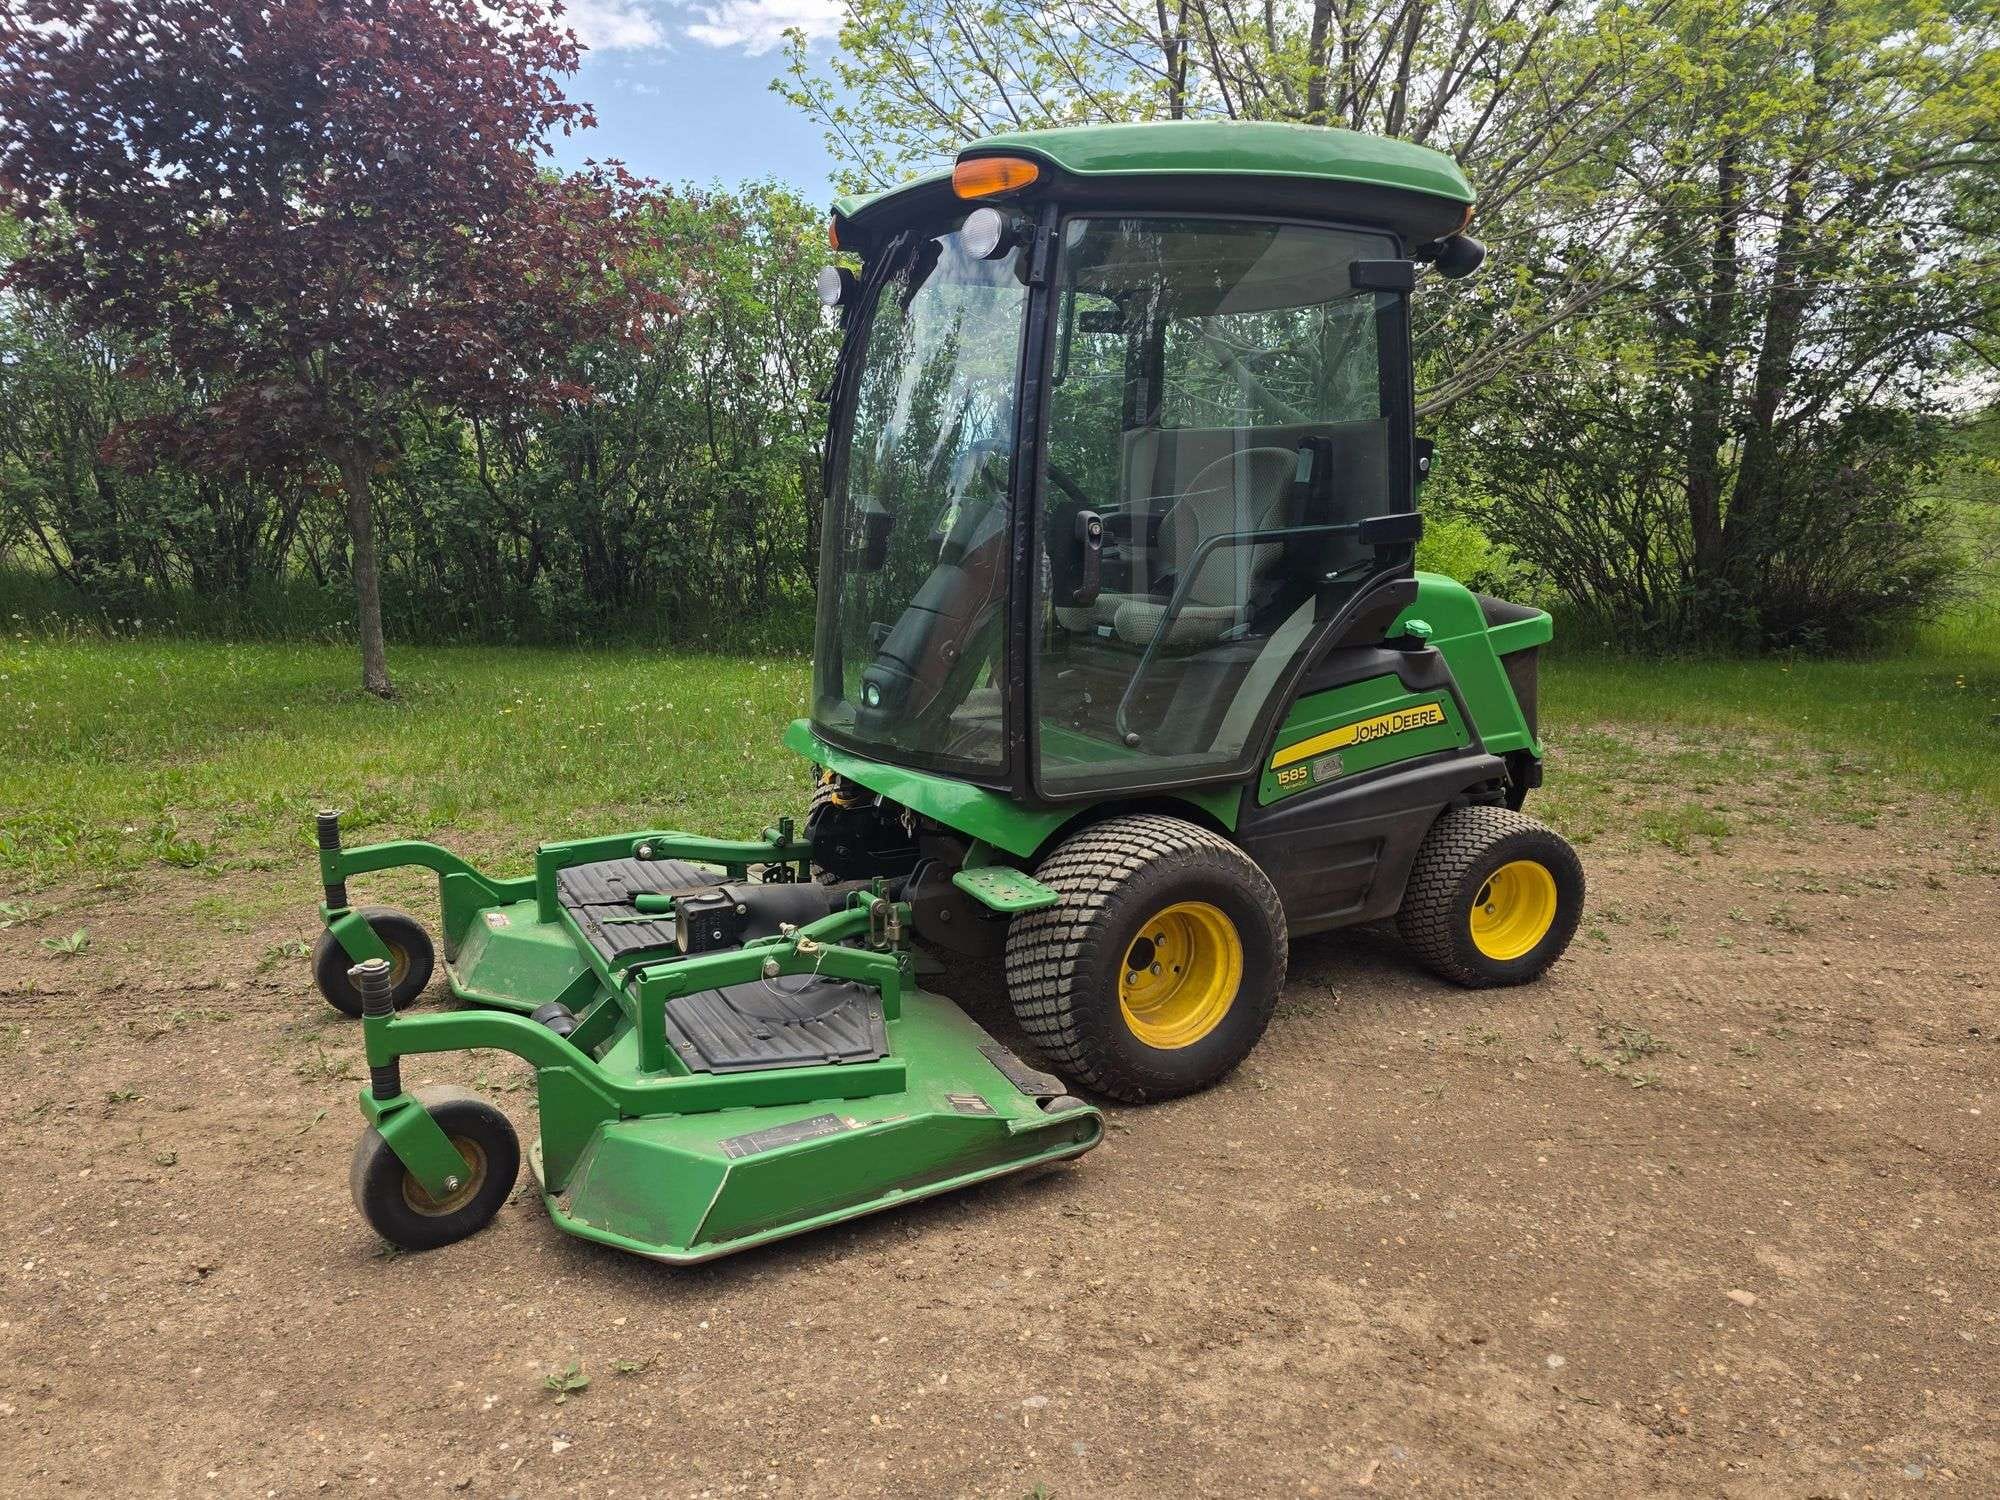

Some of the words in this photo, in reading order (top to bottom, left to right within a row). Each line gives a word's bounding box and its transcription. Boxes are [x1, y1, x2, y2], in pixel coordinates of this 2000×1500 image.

[1351, 719, 1389, 743] JOHN
[1392, 710, 1437, 731] DEERE
[1277, 766, 1308, 785] 1585
